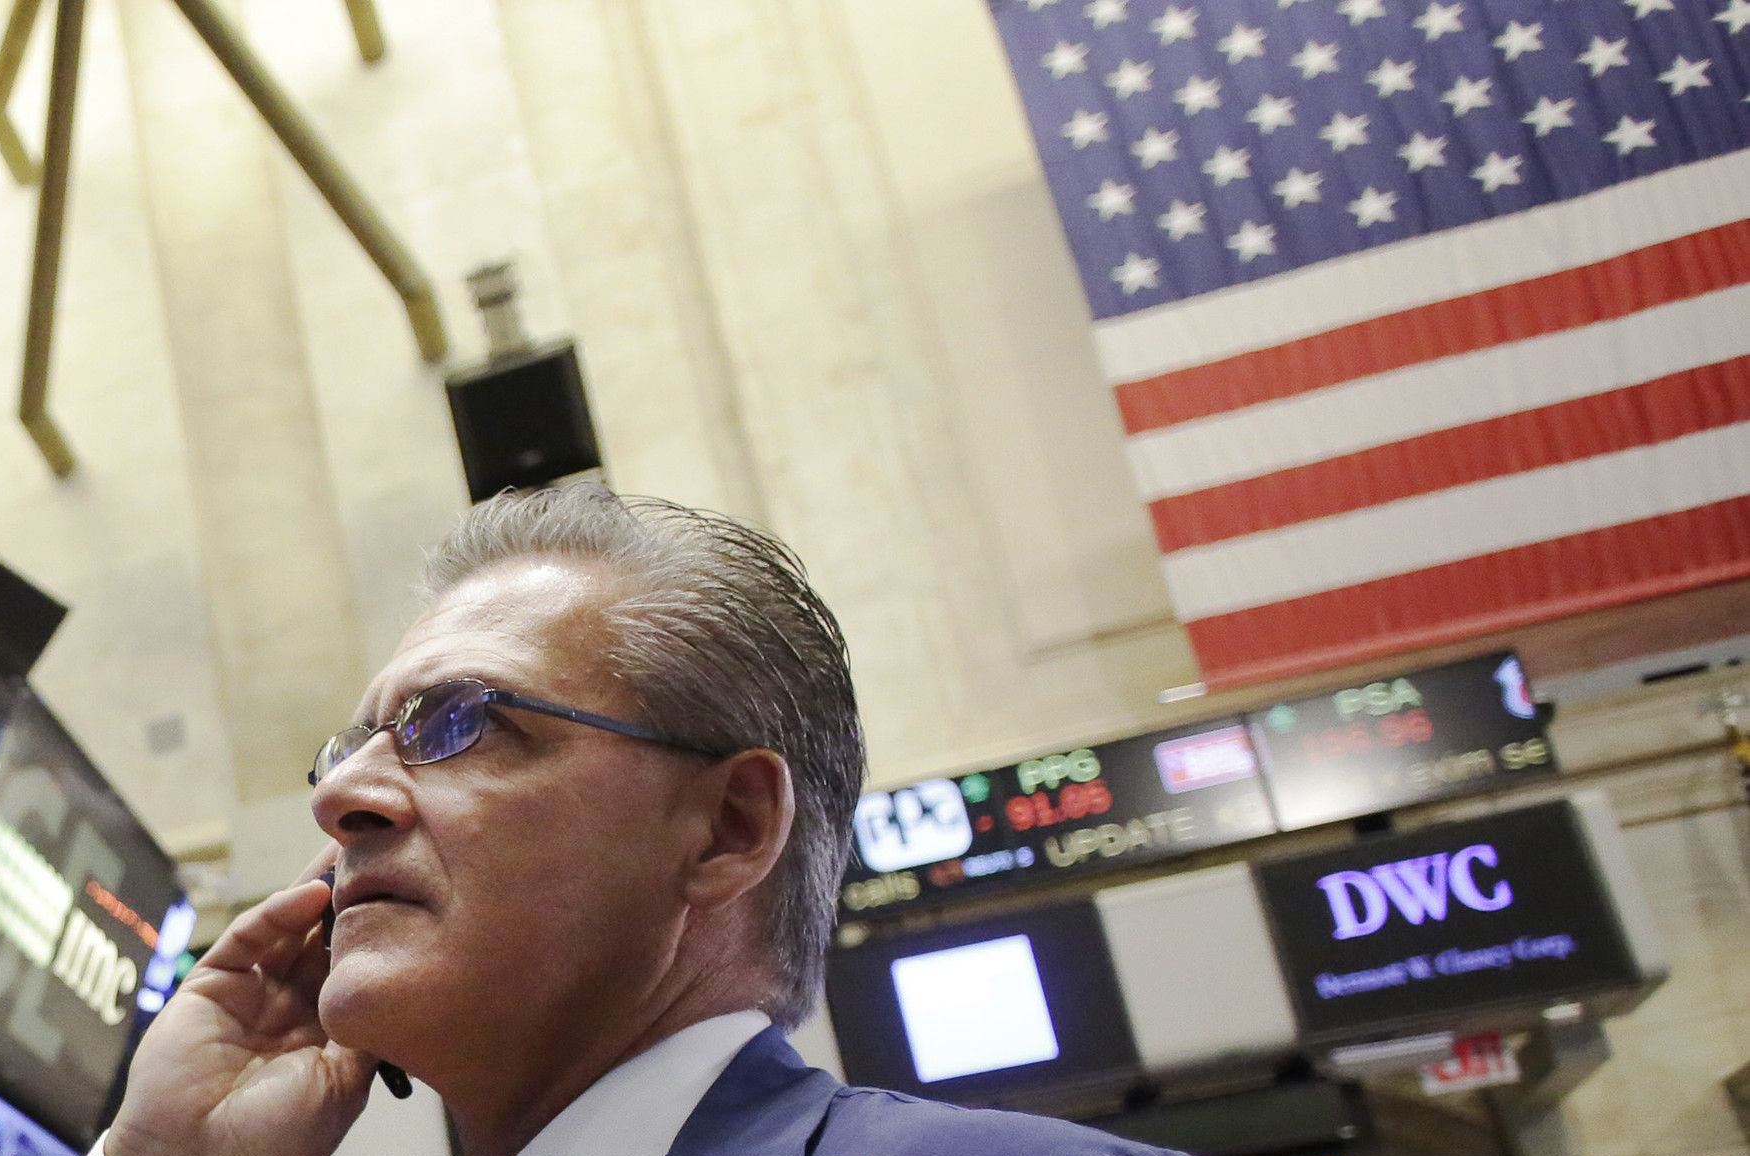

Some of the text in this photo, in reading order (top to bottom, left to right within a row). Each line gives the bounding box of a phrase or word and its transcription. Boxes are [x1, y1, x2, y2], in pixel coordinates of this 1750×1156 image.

[1017, 748, 1101, 795] PPG
[1046, 806, 1195, 868] UPDATE
[1316, 844, 1514, 940] DWC
